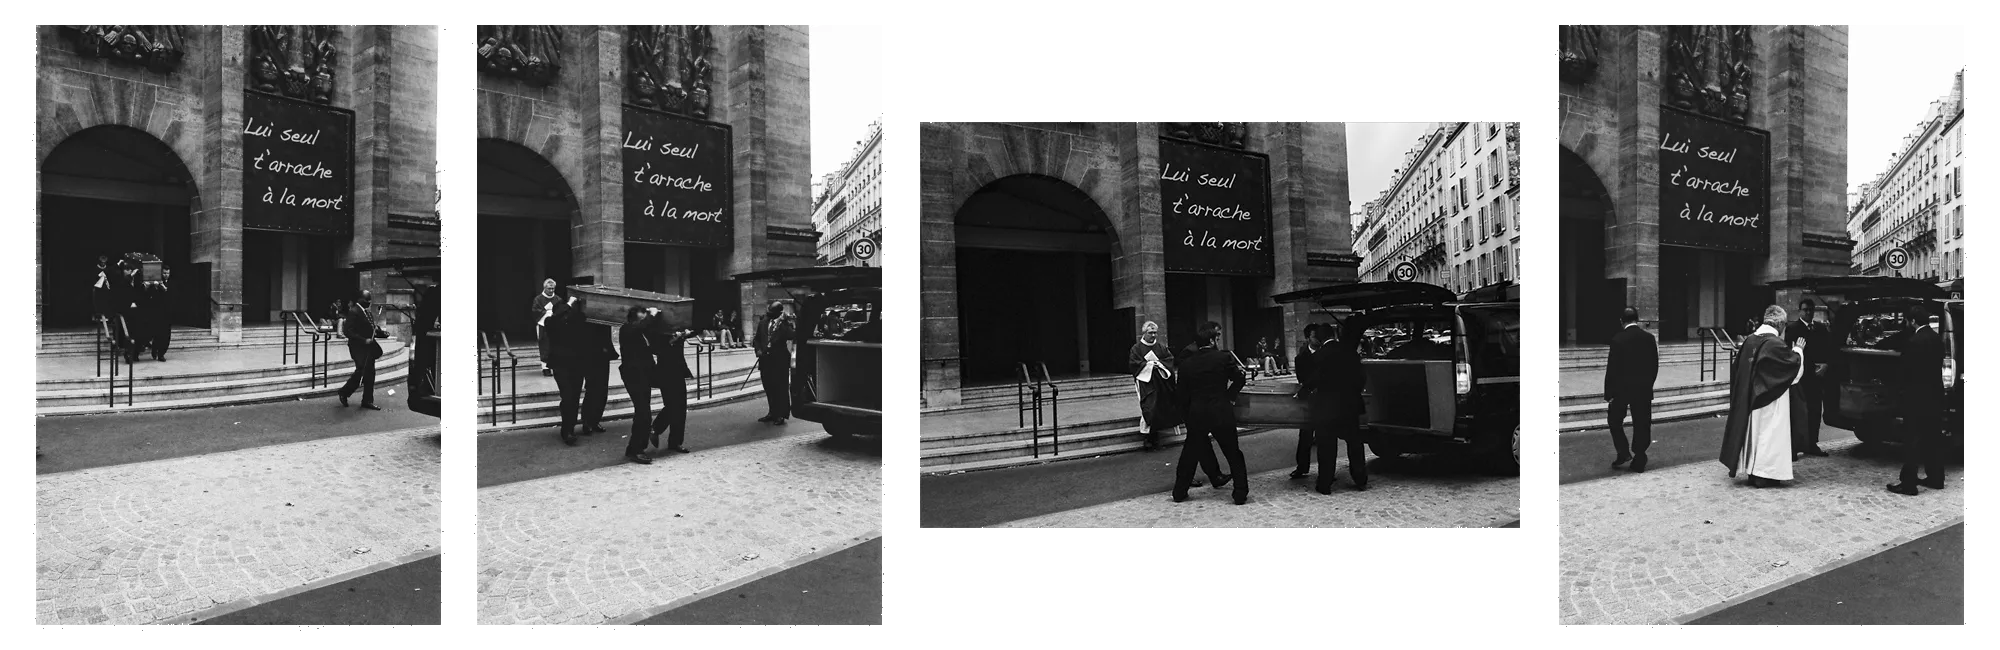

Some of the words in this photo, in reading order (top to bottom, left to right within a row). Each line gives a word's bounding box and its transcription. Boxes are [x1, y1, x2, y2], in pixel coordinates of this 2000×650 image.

[243, 116, 272, 138] Lui
[280, 129, 320, 146] seul
[623, 130, 652, 151] Lui
[659, 142, 699, 159] seul
[1660, 132, 1690, 154] Lui
[1697, 146, 1737, 164] seul
[253, 149, 333, 179] t'arrache
[634, 162, 713, 192] t'arrache
[1160, 163, 1190, 182] Lui
[1197, 173, 1237, 189] seul
[1670, 165, 1750, 197] t'arrache
[262, 187, 274, 204] à
[279, 187, 296, 207] la
[301, 194, 343, 210] mort
[643, 199, 655, 217] à
[661, 200, 678, 220] la
[682, 207, 723, 223] mort
[1172, 193, 1252, 221] t'arrache
[1679, 204, 1691, 221] à
[1697, 204, 1714, 223] la
[1718, 213, 1760, 228] mort
[857, 244, 872, 255] 30
[1183, 230, 1195, 247] à
[1200, 230, 1217, 249] la
[1222, 235, 1262, 251] mort
[1890, 254, 1904, 264] 30
[1398, 267, 1413, 278] 30
